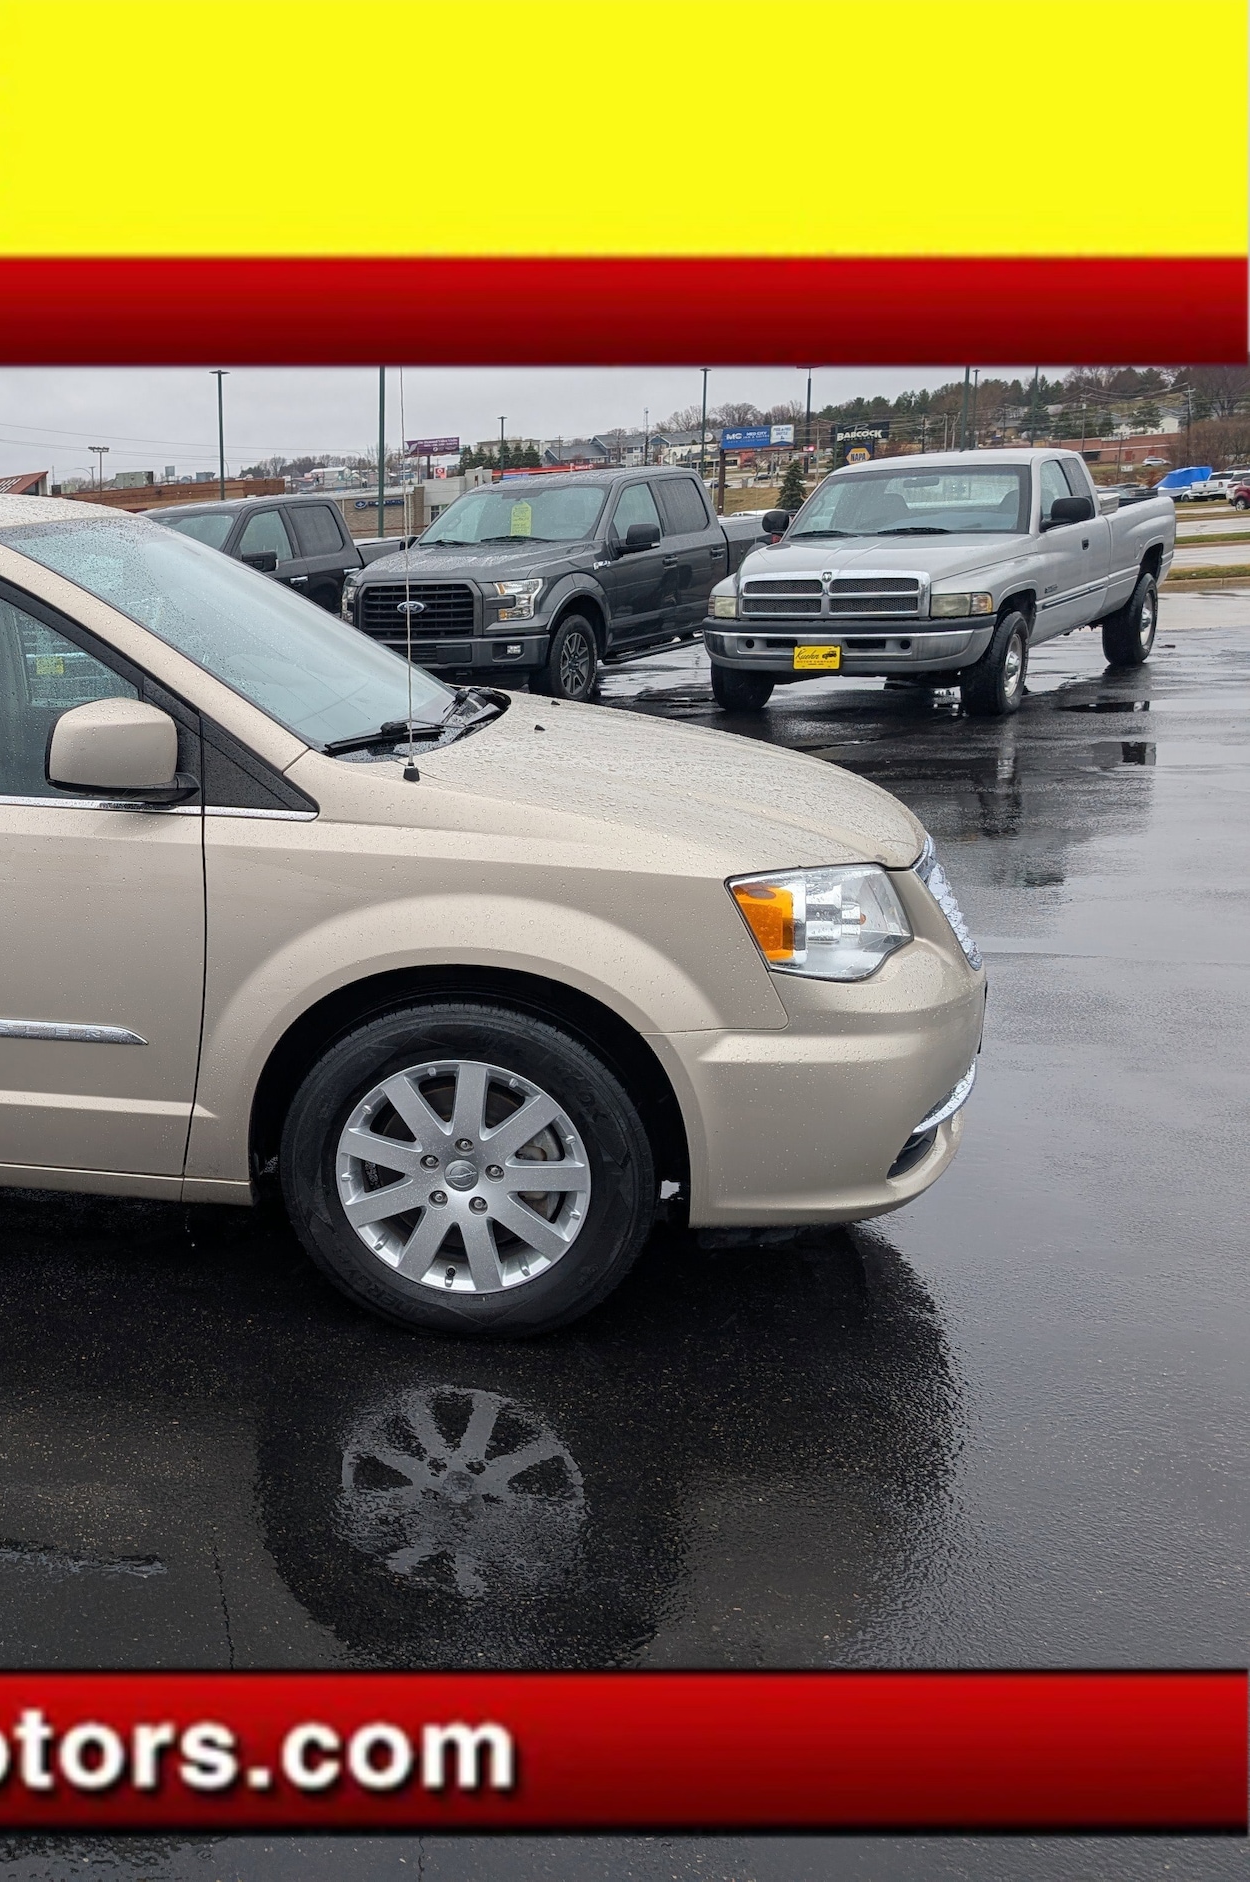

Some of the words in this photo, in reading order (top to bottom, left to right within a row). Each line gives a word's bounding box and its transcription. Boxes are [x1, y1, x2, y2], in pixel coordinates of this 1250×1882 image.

[836, 429, 883, 441] BABCOCK
[851, 452, 866, 461] NAPA
[796, 648, 819, 661] Kuehn
